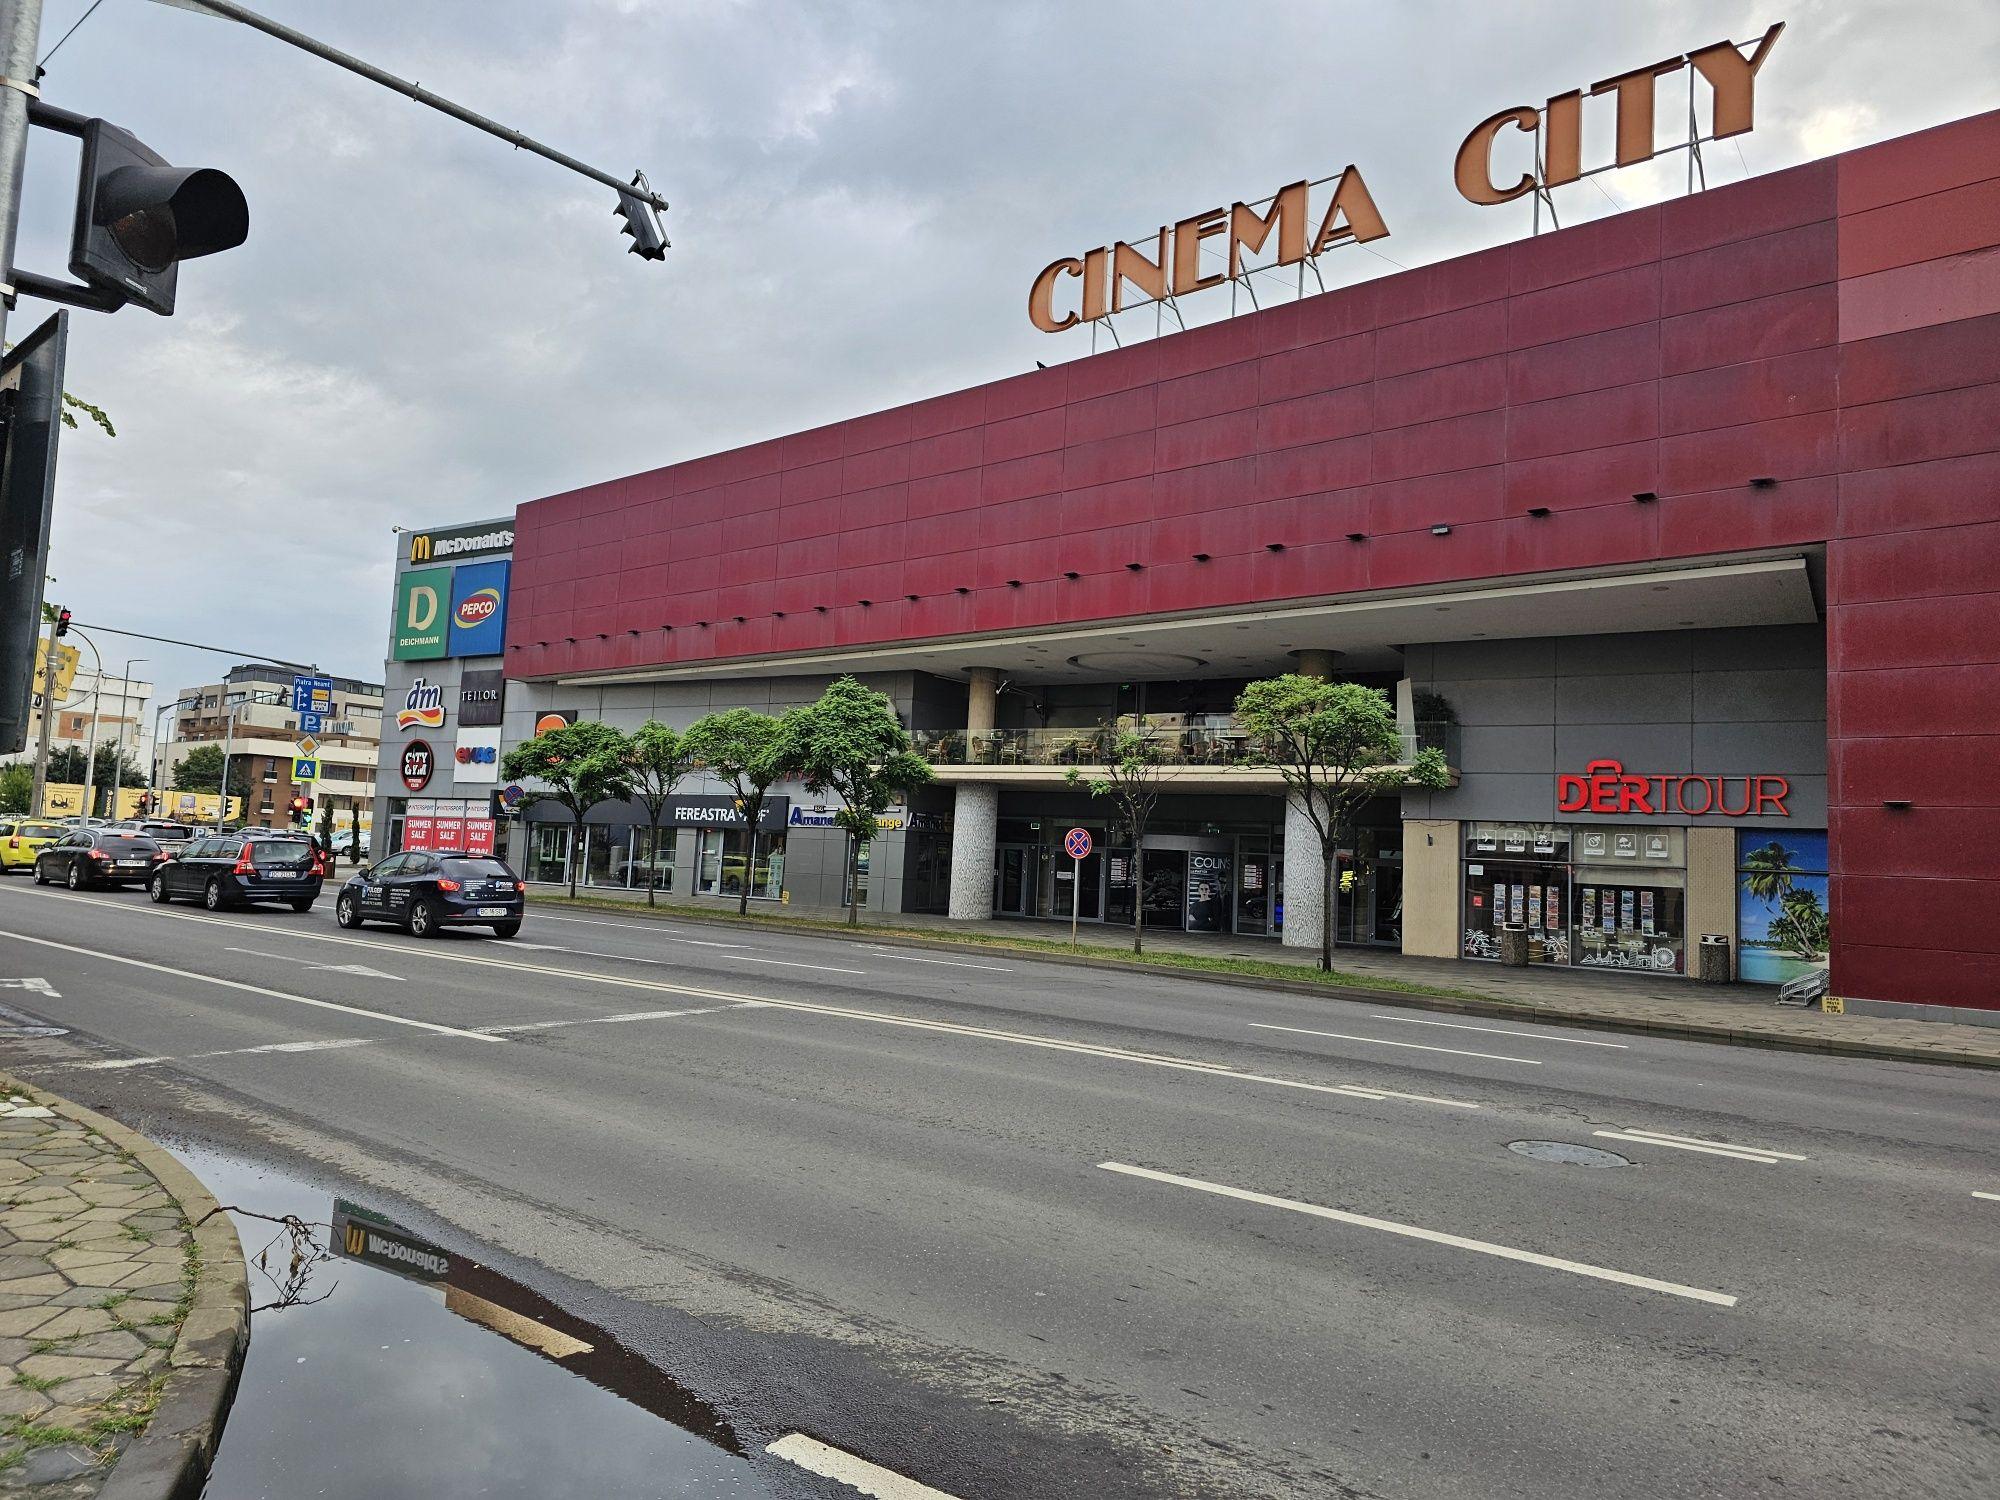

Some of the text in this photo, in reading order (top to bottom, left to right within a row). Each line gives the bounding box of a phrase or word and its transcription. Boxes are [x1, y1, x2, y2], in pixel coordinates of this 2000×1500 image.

[1028, 21, 1786, 333] CINEMA CITY
[434, 530, 514, 556] McDonald's
[408, 586, 438, 631] D
[461, 601, 493, 616] PEPCO
[400, 636, 439, 647] DEICHMANN
[407, 680, 440, 710] dm
[461, 689, 498, 702] TEILOR
[405, 751, 428, 763] CITY
[405, 763, 427, 775] GYM
[1558, 760, 1790, 818] DERTOUR
[675, 807, 736, 822] FEREASTRA
[789, 806, 834, 826] Amane
[408, 819, 432, 829] SUMMER
[436, 820, 461, 830] SUMMER
[467, 821, 493, 831] SUMMER
[1194, 857, 1231, 869] COLIN'S
